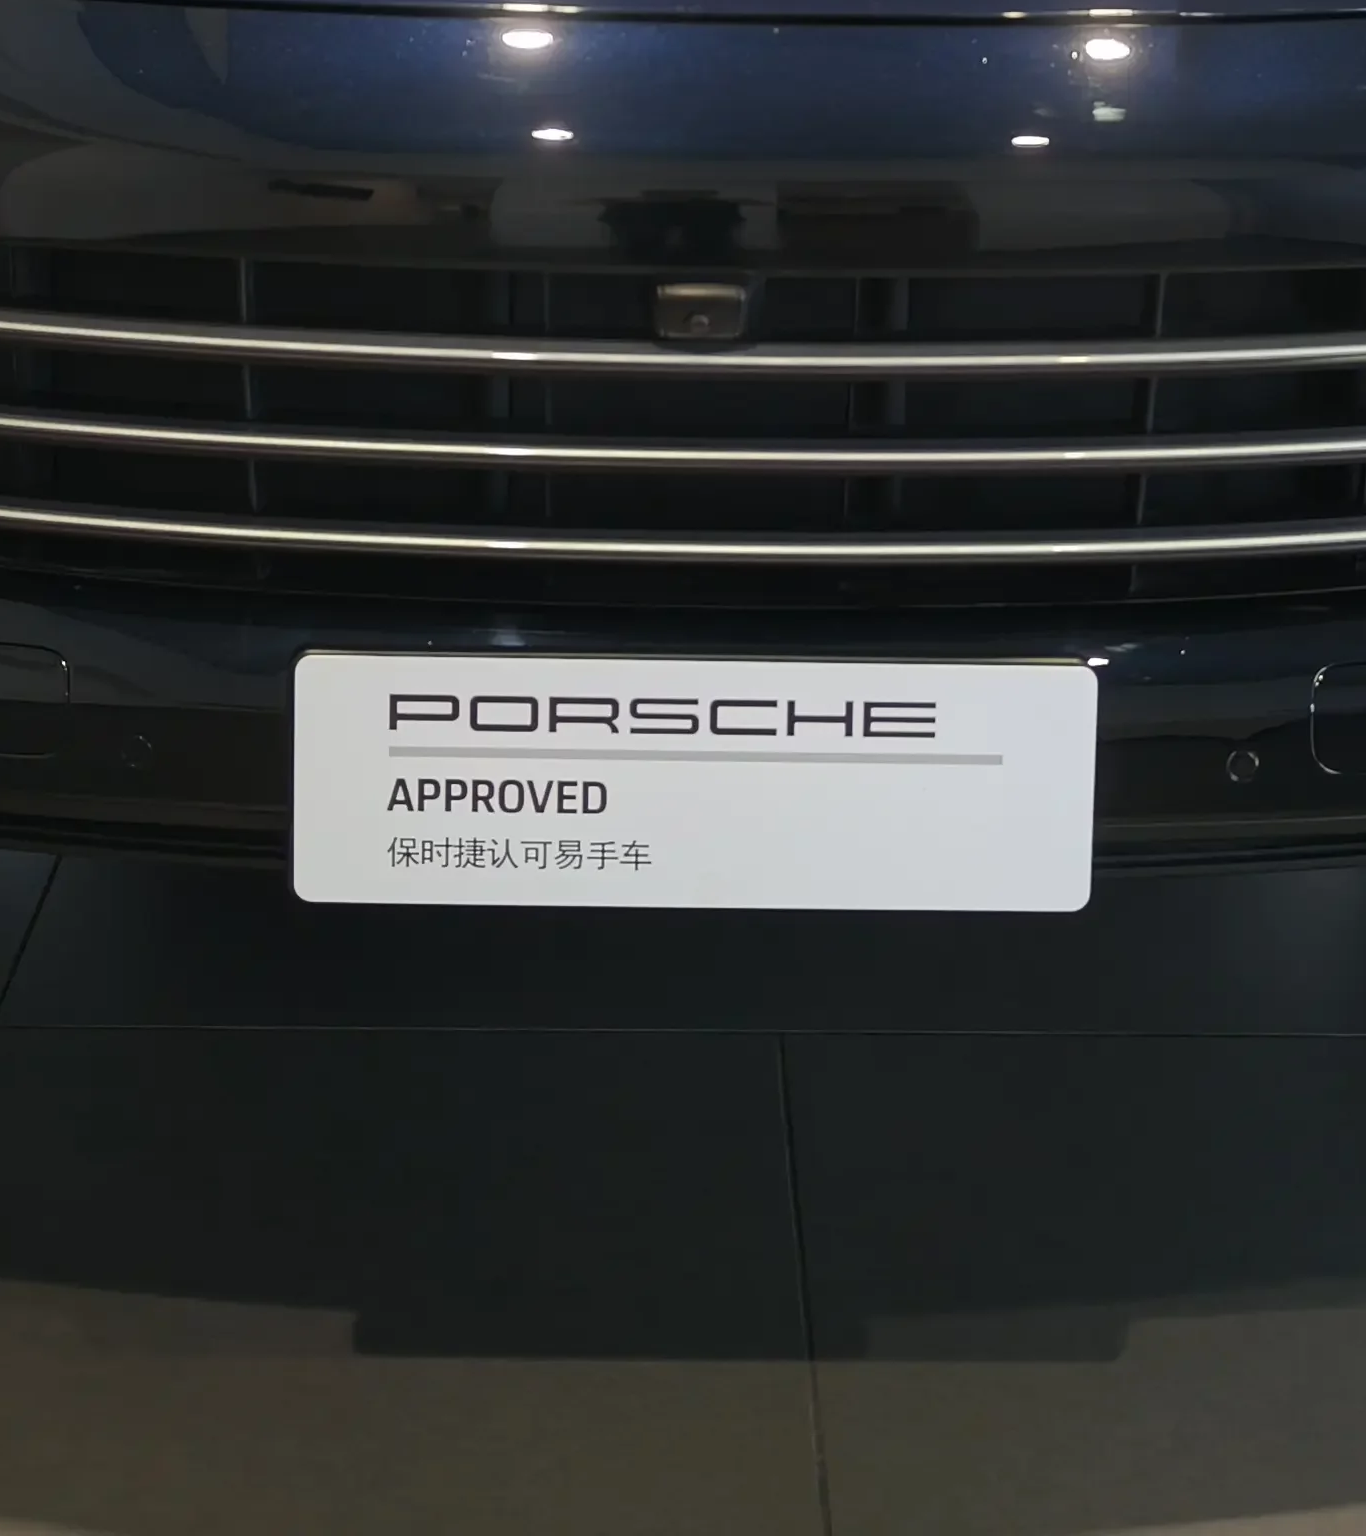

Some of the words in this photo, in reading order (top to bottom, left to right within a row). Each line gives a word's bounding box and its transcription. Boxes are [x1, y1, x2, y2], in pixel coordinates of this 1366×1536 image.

[389, 693, 937, 739] PORSCHE
[387, 778, 608, 814] APPROVED
[387, 836, 652, 871] 保时捷认可易手车
